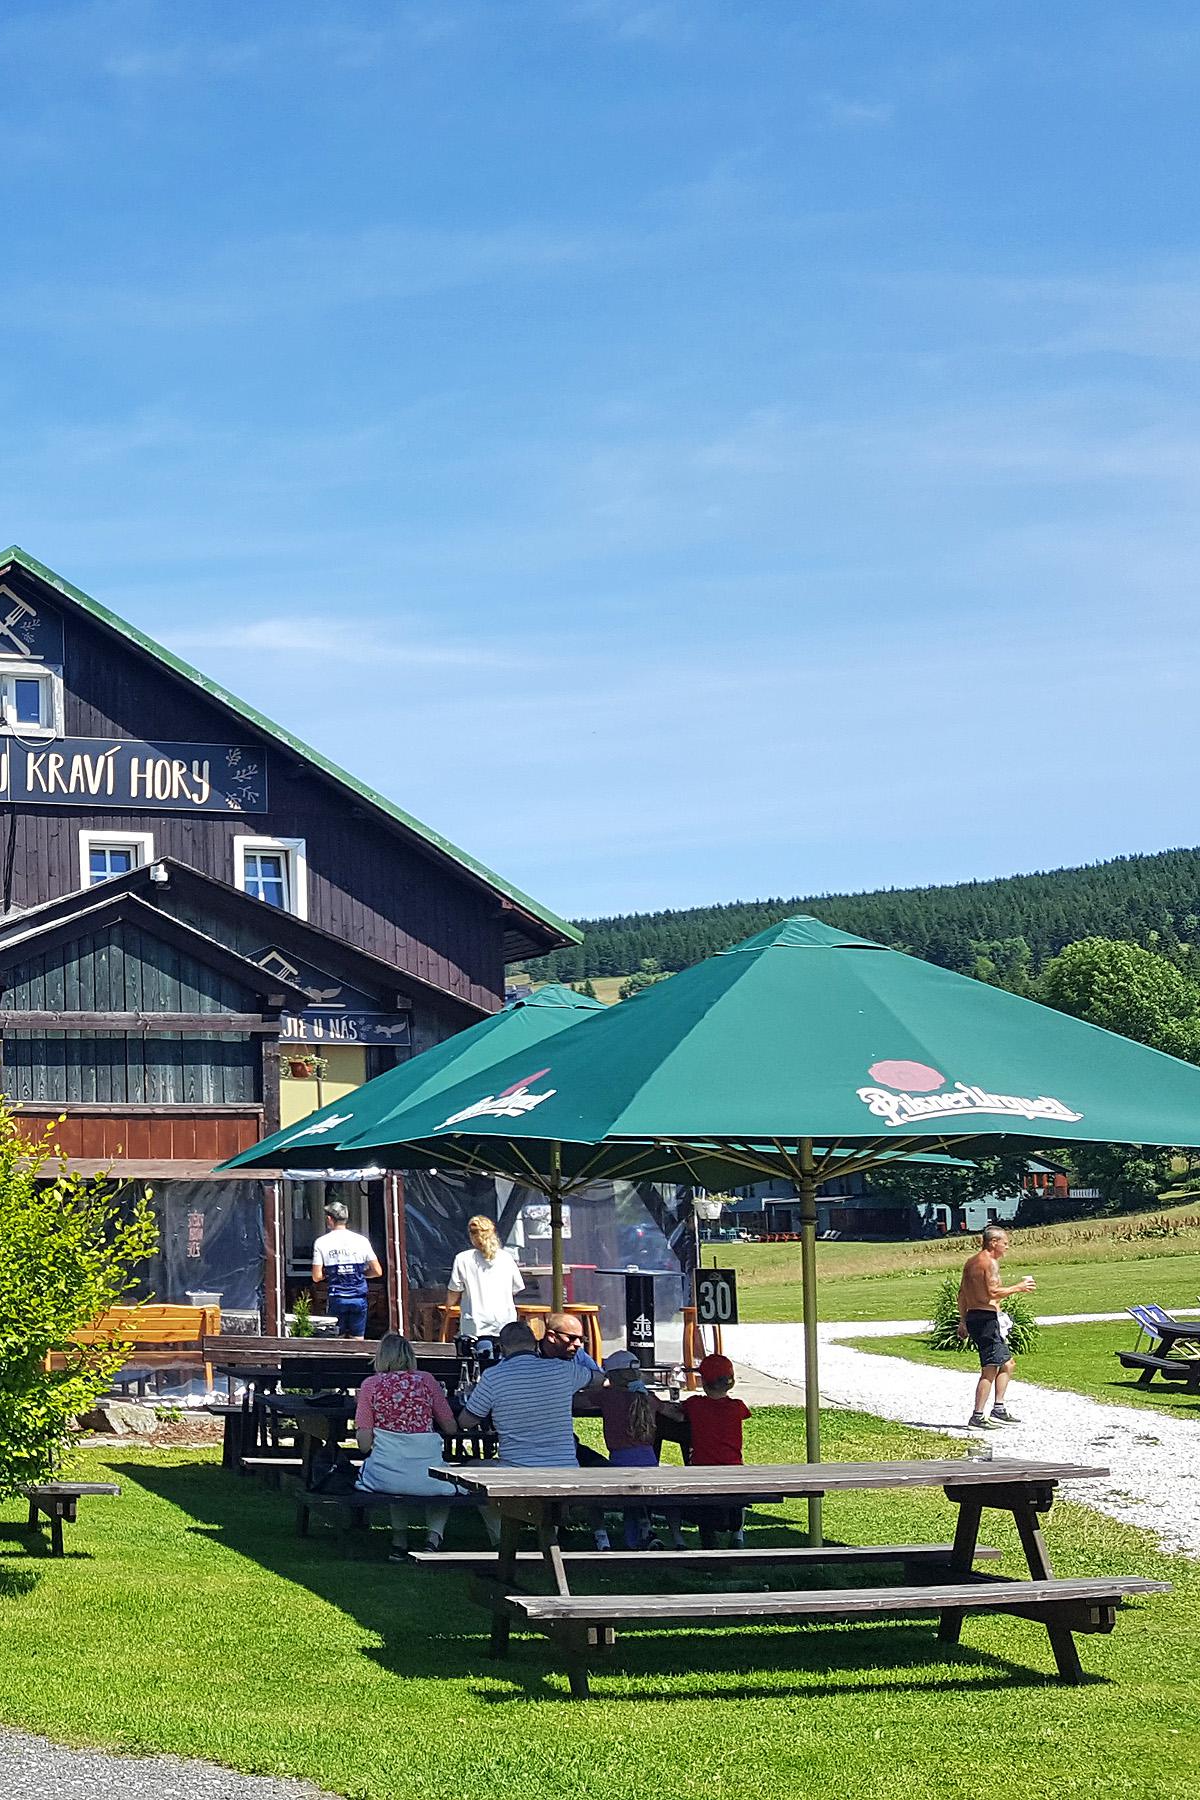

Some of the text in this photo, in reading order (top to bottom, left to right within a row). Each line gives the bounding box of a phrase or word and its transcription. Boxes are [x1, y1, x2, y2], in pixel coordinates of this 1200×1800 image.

[26, 745, 122, 796] KRAVÍ
[130, 757, 210, 805] HORY
[313, 1018, 324, 1039] U
[330, 1014, 358, 1040] NÁS
[856, 1081, 1084, 1127] Pilsner Urquell
[700, 1281, 732, 1320] 30
